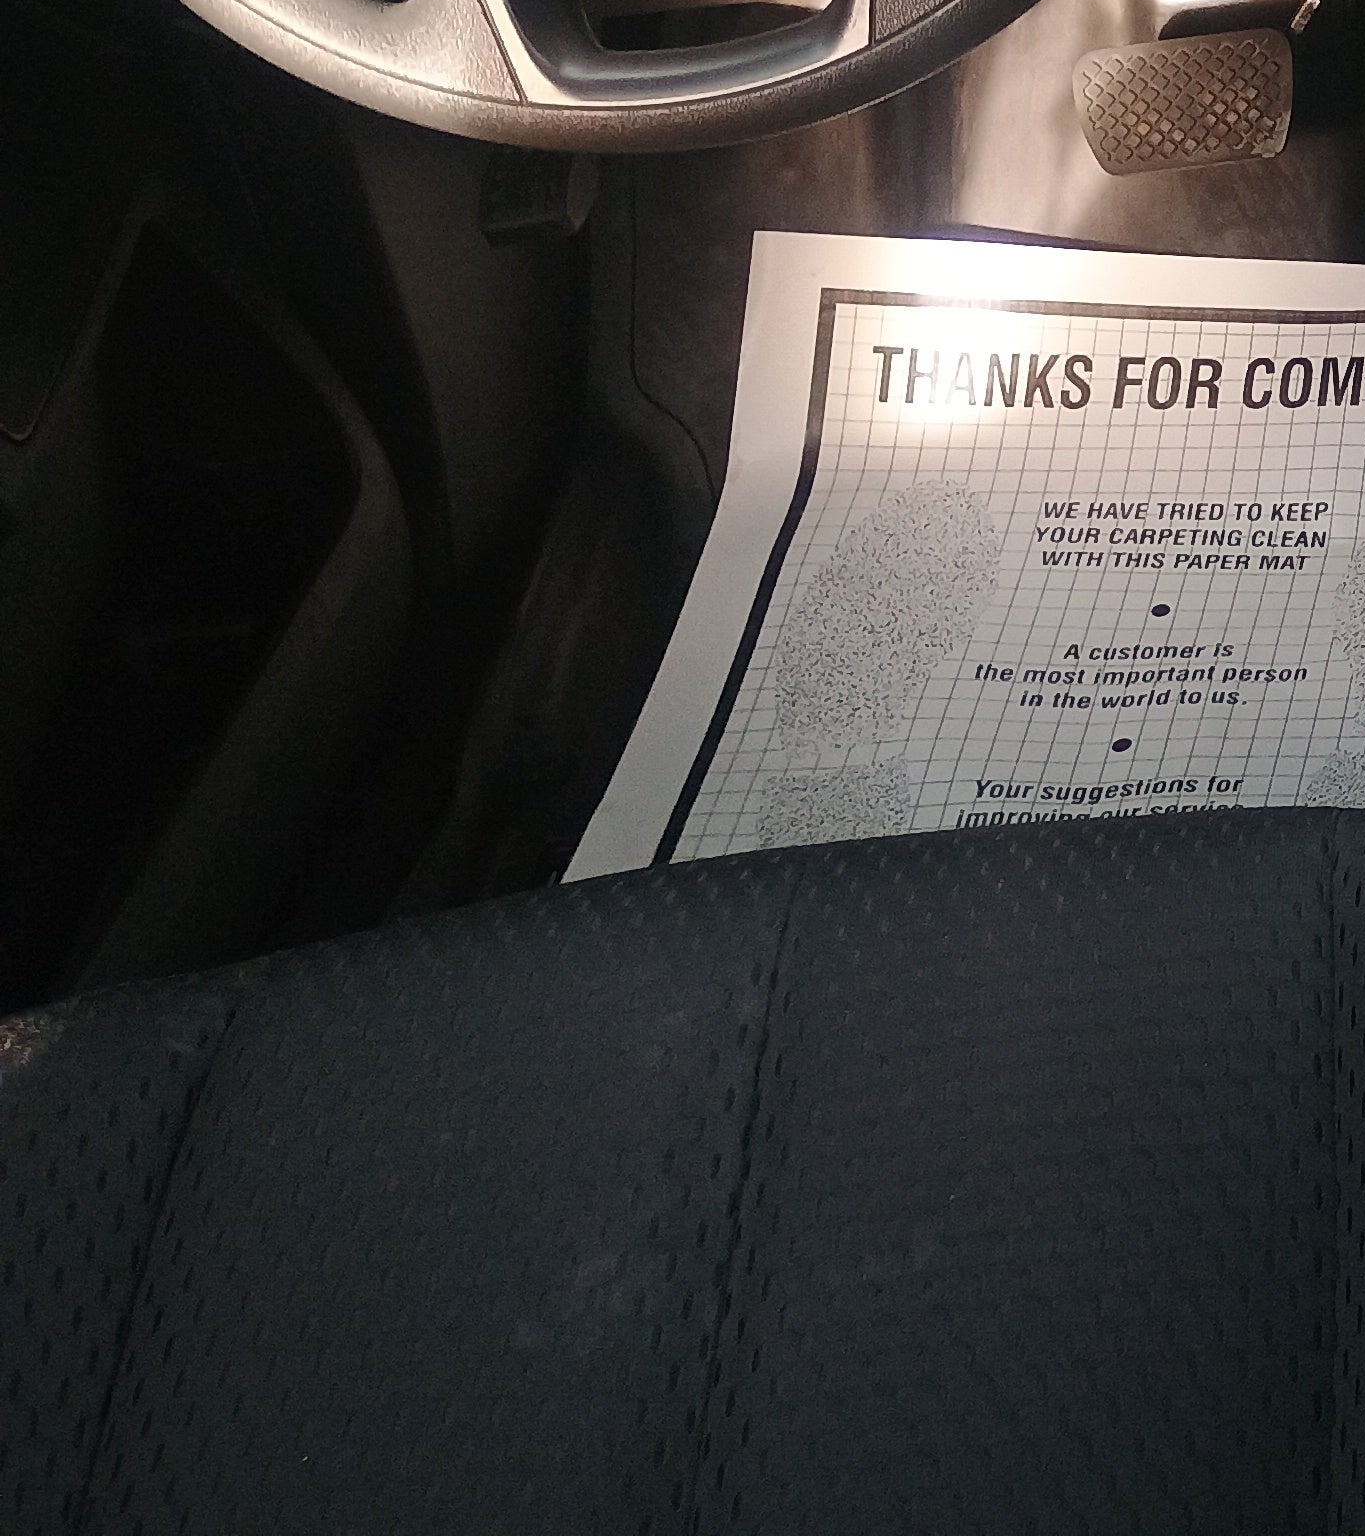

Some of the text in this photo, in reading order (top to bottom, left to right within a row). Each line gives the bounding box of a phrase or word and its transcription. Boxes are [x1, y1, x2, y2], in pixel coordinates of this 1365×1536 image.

[872, 346, 1093, 409] THANKS
[1112, 356, 1222, 409] FOR
[1043, 501, 1329, 521] WE HAVE TRIED TO KEEP
[1035, 526, 1327, 548] YOUR CARPETING CLEAN
[1042, 550, 1310, 570] WITH THIS PAPER MAT
[1063, 643, 1235, 660] A customer is
[974, 664, 1307, 689] the most important person
[1020, 690, 1248, 709] in the world to us.
[975, 776, 1244, 805] Your suggestions for
